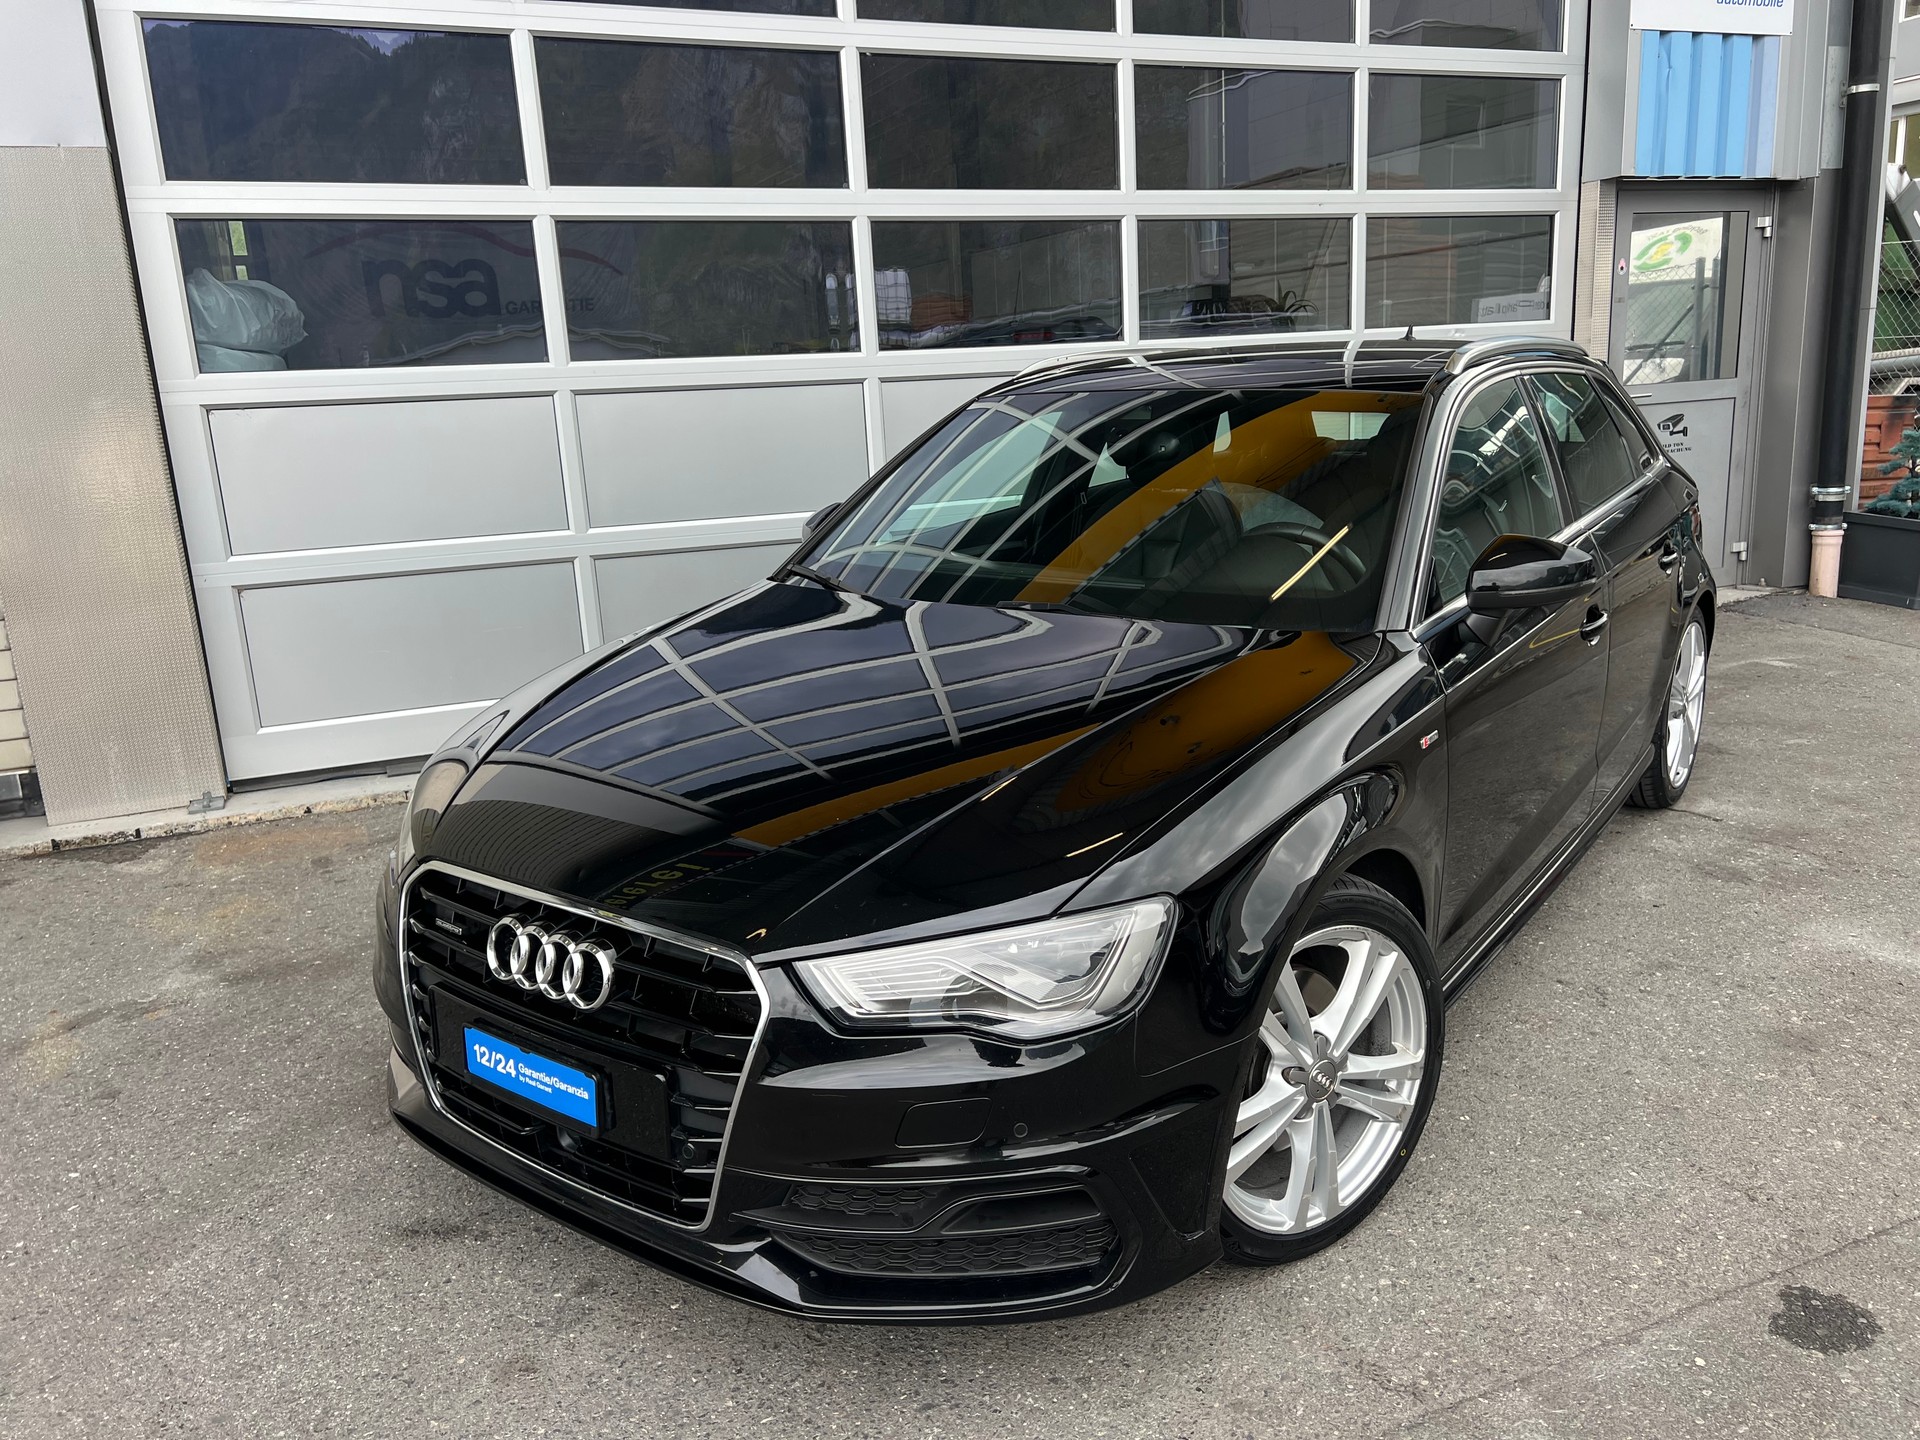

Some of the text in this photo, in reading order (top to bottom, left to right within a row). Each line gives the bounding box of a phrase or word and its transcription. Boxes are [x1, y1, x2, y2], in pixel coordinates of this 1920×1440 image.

[361, 258, 595, 319] nsa GARTIE
[473, 1043, 589, 1100] 12/24 Garantie/Garanzia
